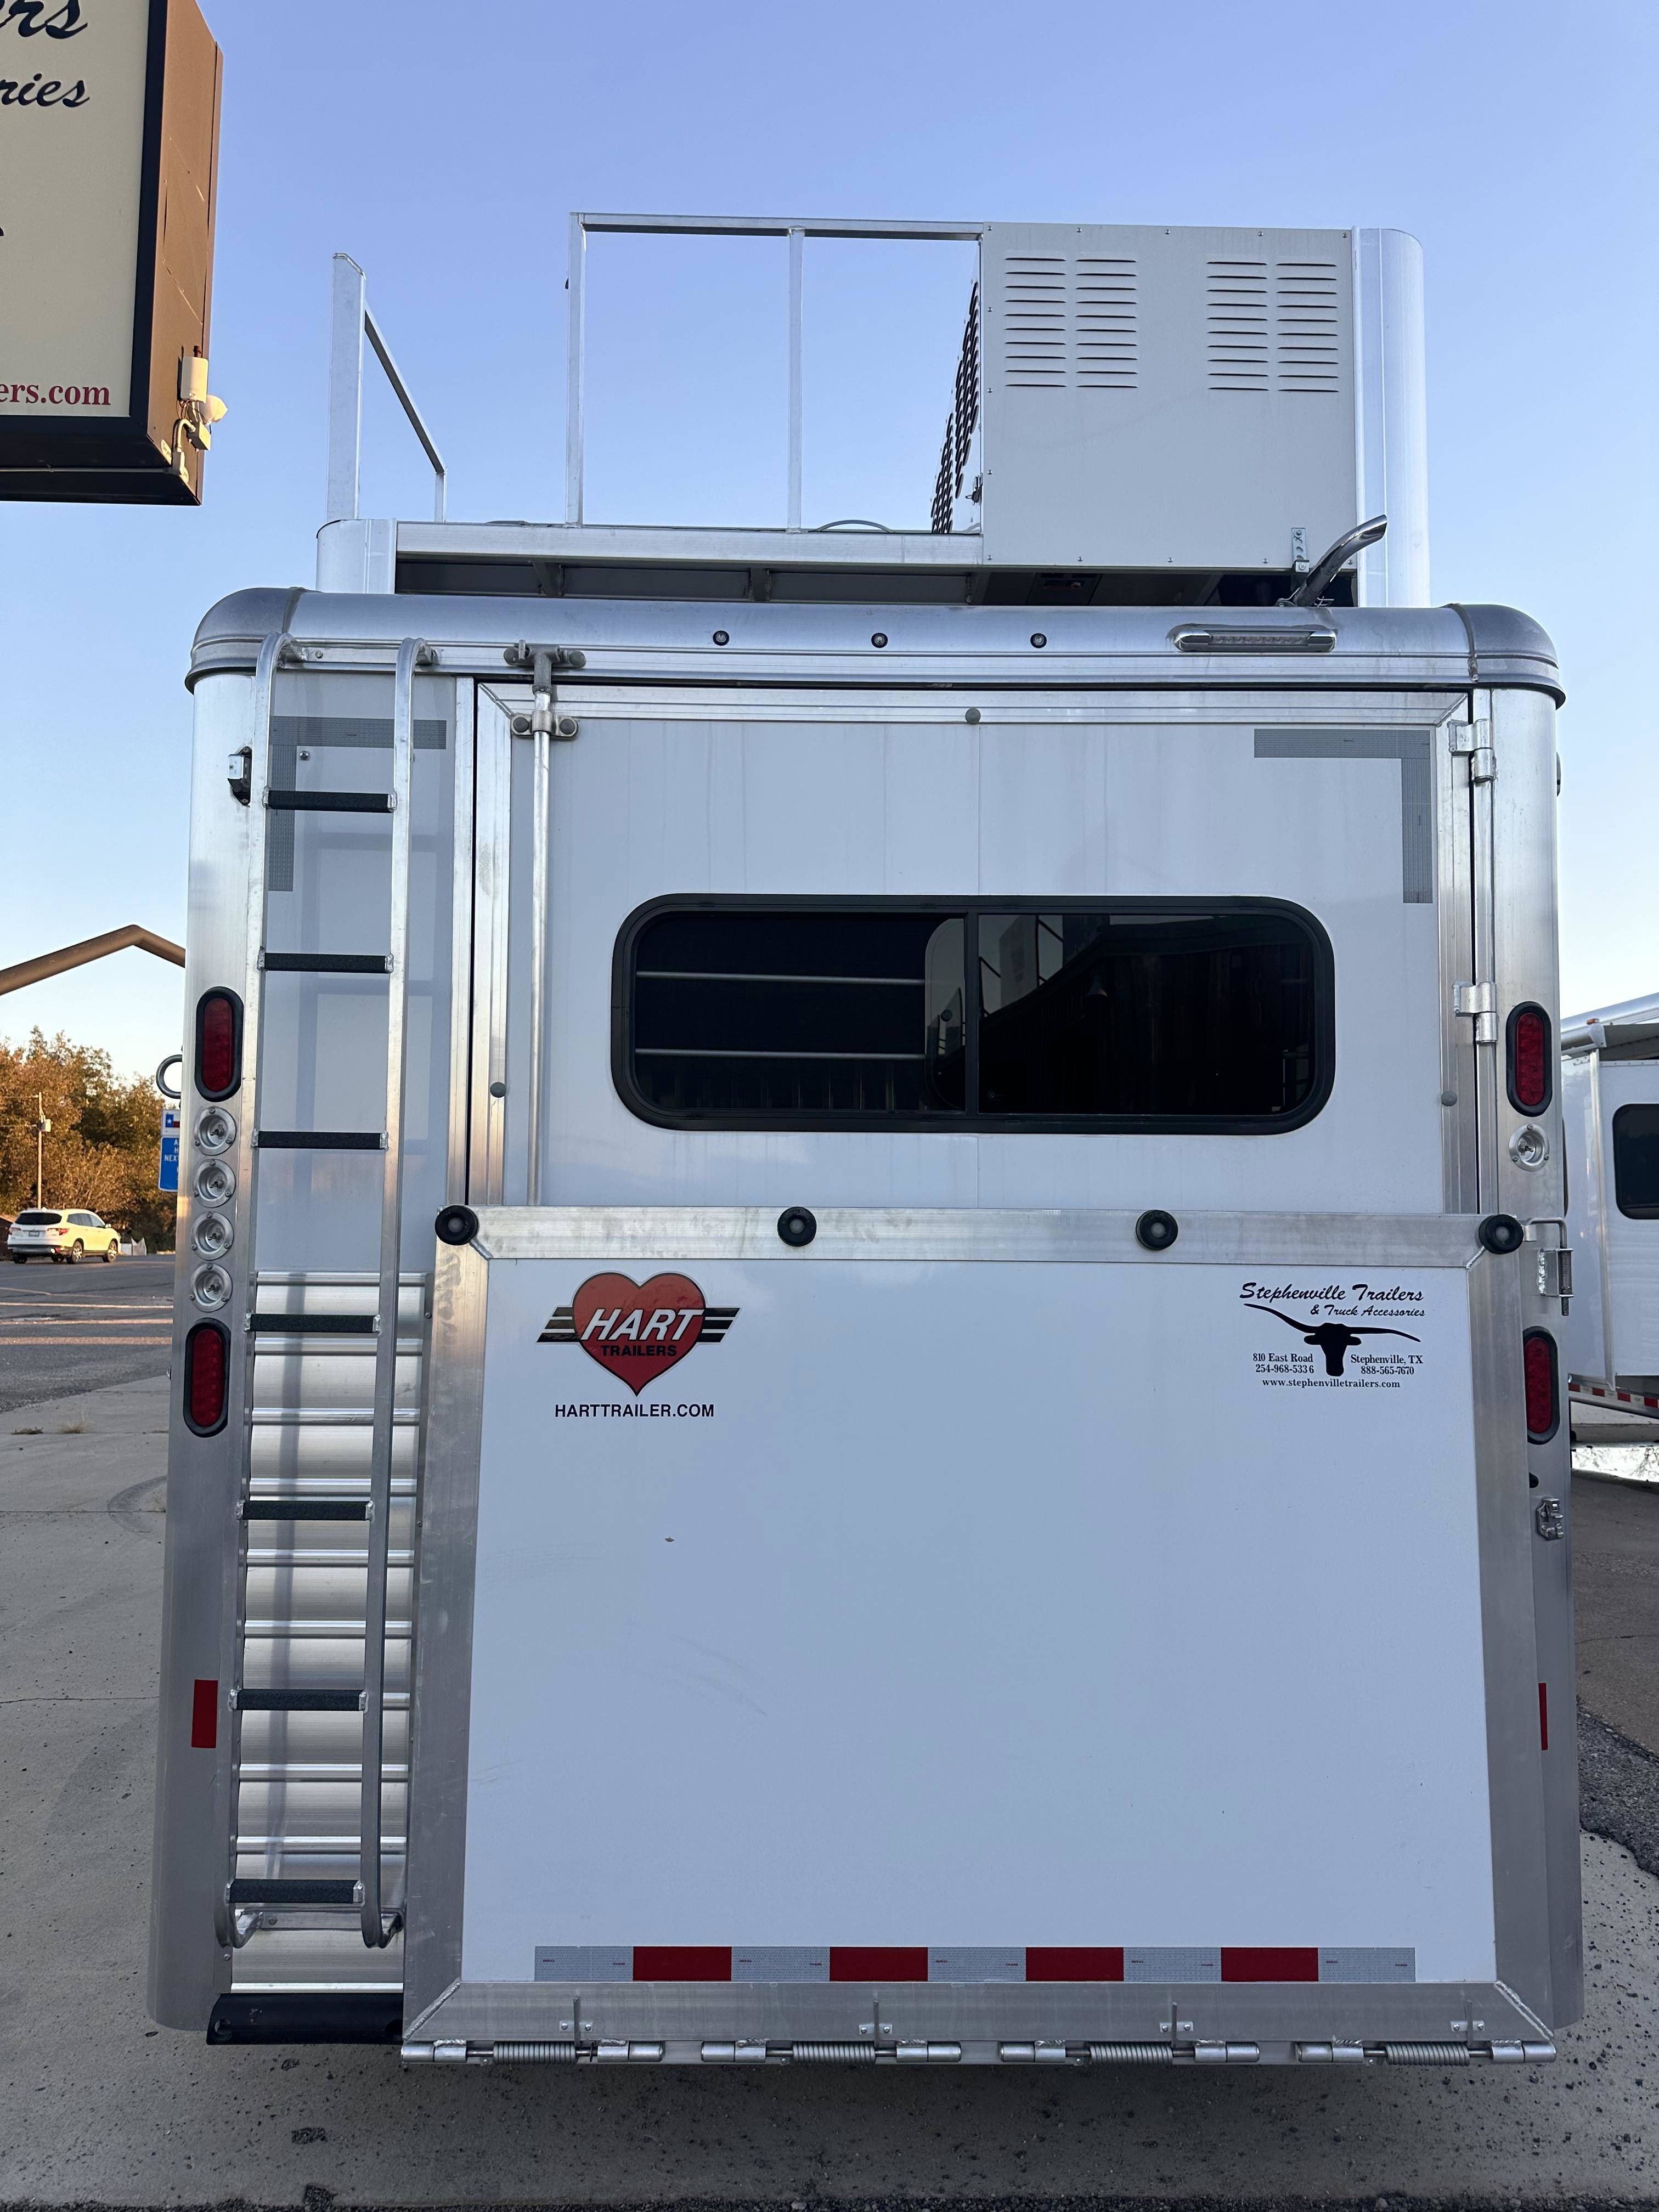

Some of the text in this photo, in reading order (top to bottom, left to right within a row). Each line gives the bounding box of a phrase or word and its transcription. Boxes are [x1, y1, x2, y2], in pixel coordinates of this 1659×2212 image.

[0, 0, 88, 39] rs
[1239, 1282, 1424, 1303] Stephenville Trailers
[1310, 1304, 1425, 1317] & Truck Accessories
[580, 1308, 706, 1341] HART
[601, 1345, 678, 1357] TRAILERS
[1252, 1353, 1313, 1363] 810 East Road
[1351, 1354, 1424, 1365] Stephenville, TX
[1255, 1364, 1314, 1374] 254-968-5336
[1361, 1366, 1414, 1375] 888-565-7670
[1262, 1378, 1401, 1389] www.stephenvilletrailers.com
[555, 1403, 714, 1418] HARTTRAILER.COM
